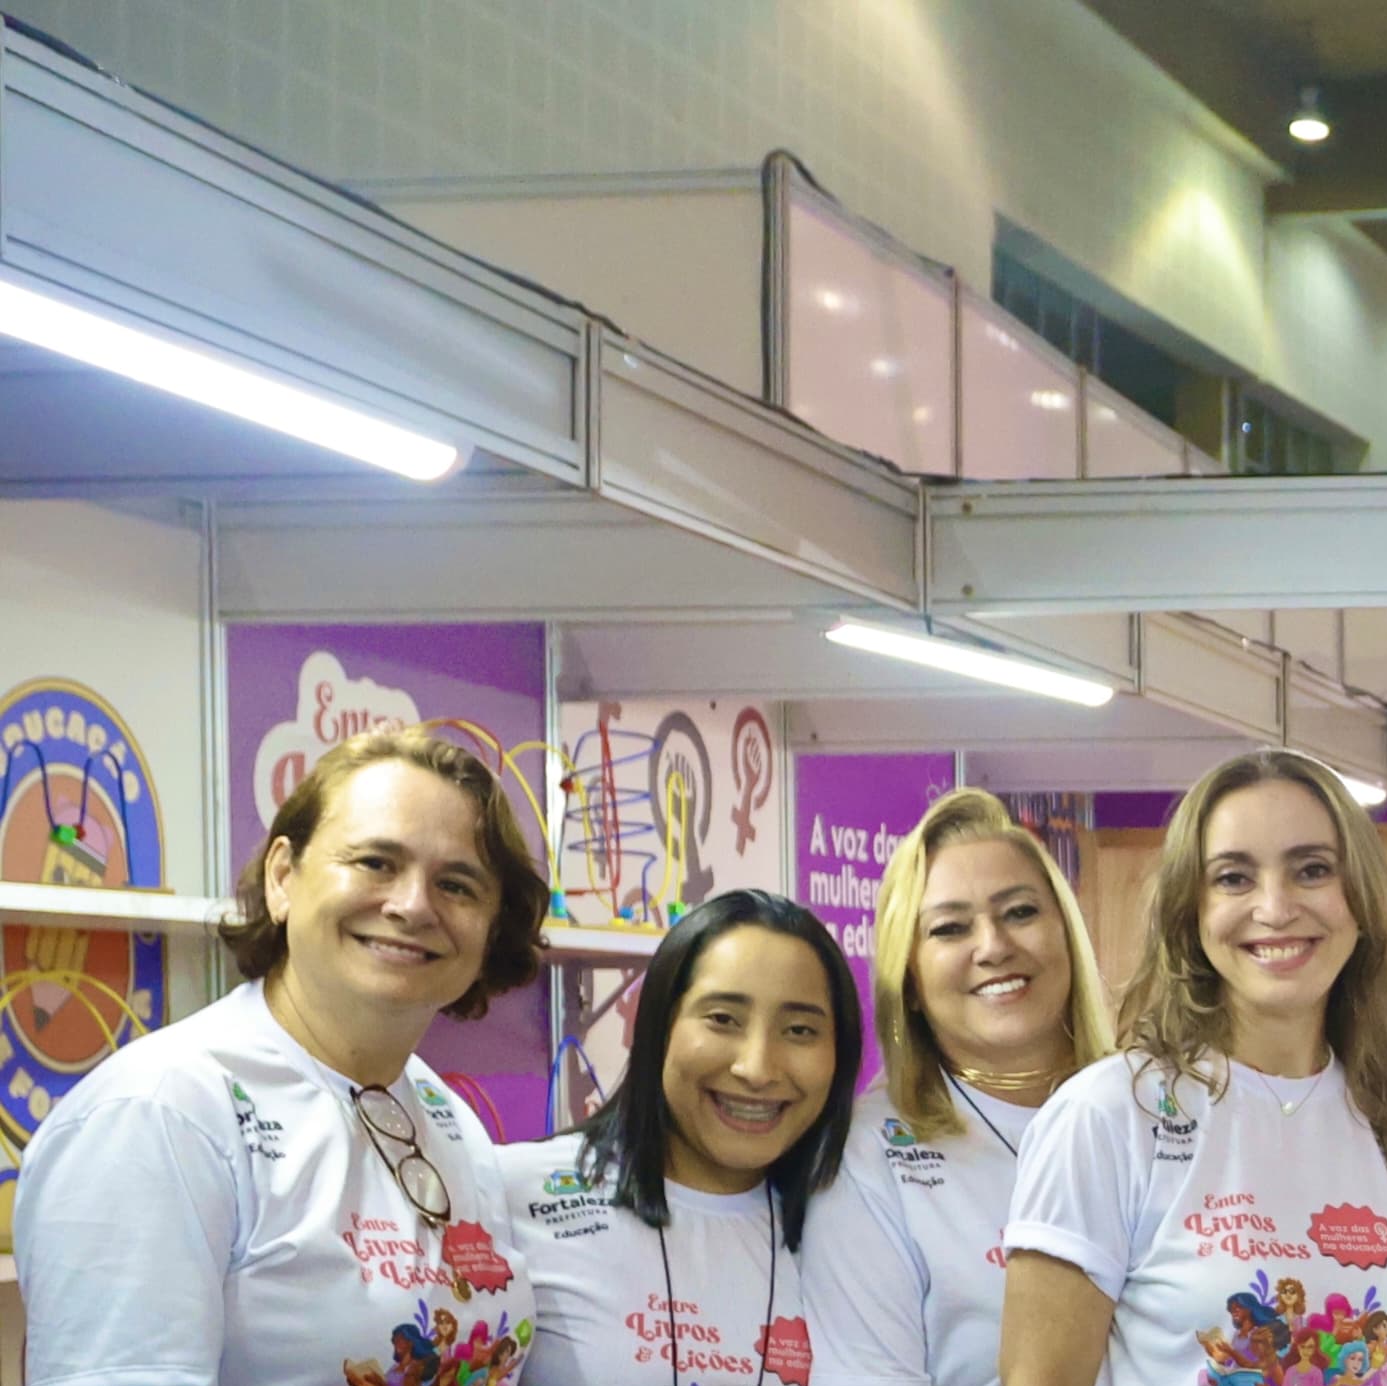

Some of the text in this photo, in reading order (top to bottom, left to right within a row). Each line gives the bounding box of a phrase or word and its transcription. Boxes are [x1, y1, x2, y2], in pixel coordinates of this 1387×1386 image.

[0, 705, 139, 803] DUCAÇÃO
[810, 814, 828, 857] A
[831, 824, 869, 862] voz
[1152, 1150, 1194, 1162] ducação
[1204, 1193, 1255, 1210] Entre
[554, 1221, 609, 1239] Educação
[1184, 1213, 1276, 1237] Livros
[1319, 1223, 1327, 1231] A
[1220, 1233, 1312, 1261] Lições
[626, 1312, 721, 1343] Livros
[660, 1342, 754, 1375] Lições
